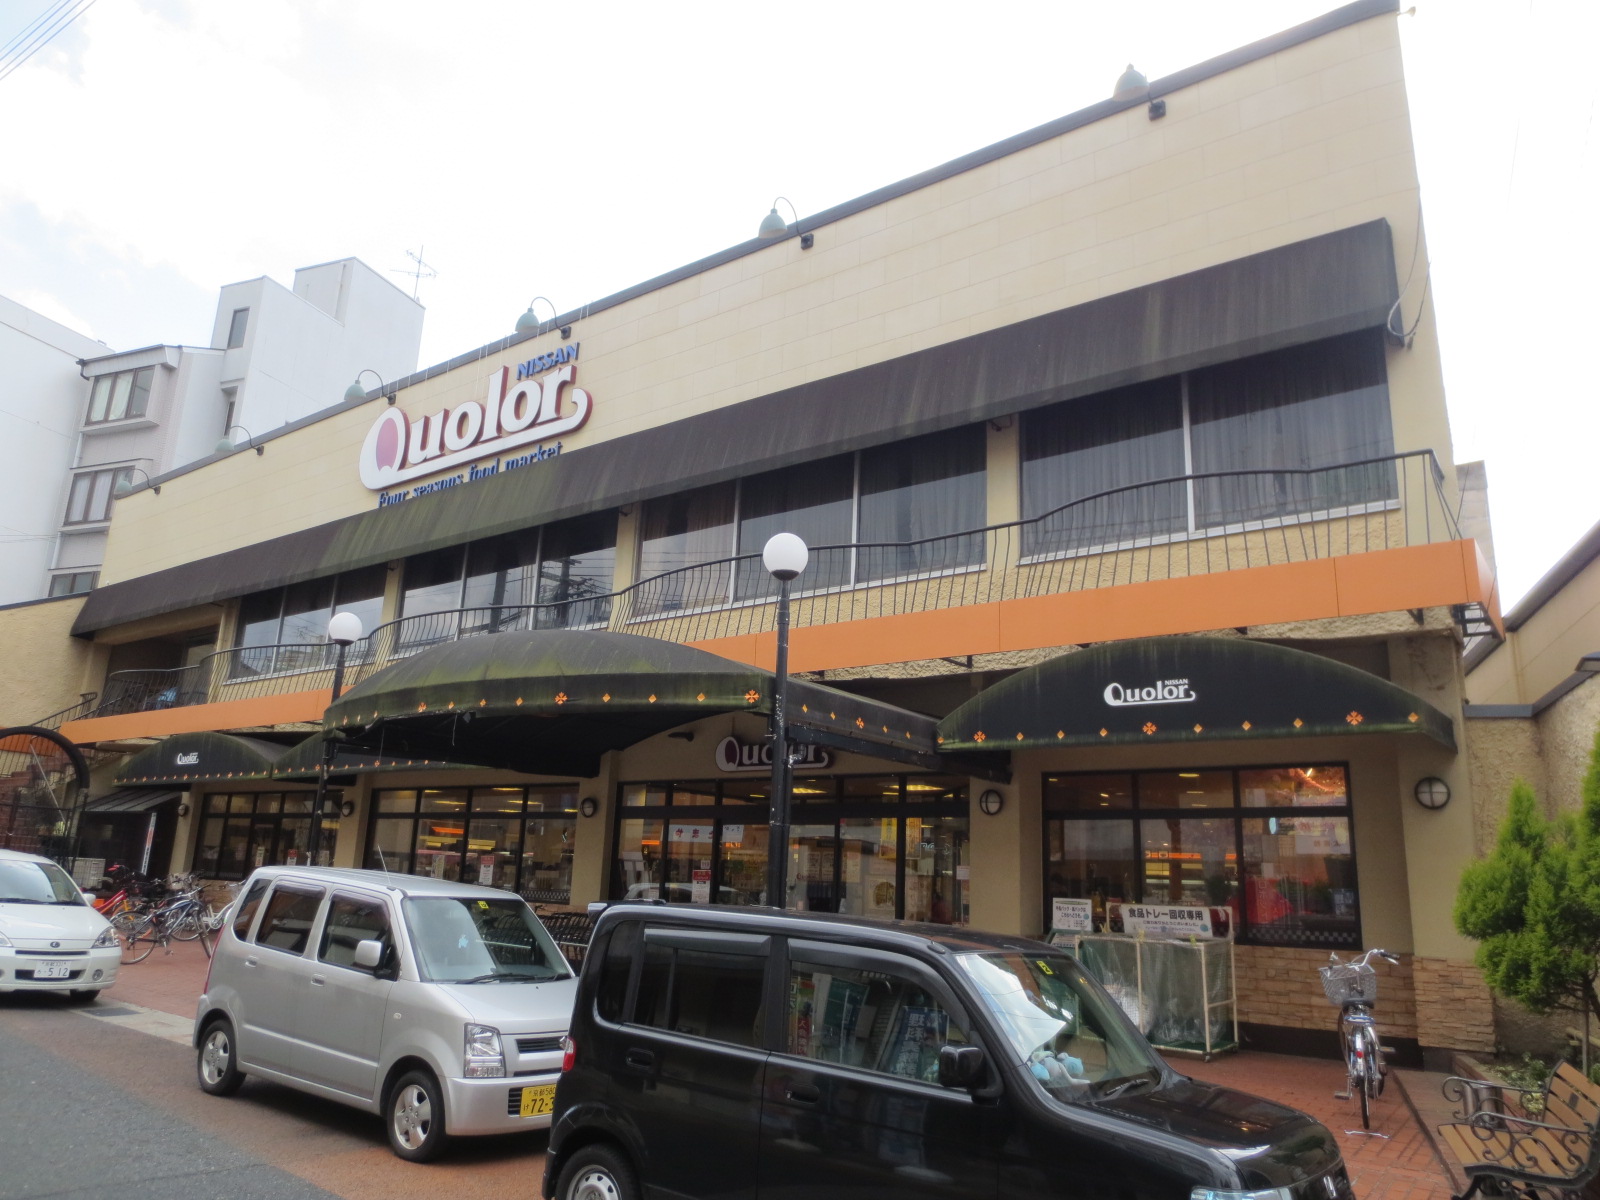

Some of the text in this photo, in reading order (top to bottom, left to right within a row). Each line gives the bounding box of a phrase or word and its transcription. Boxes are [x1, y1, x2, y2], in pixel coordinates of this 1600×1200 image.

[516, 341, 580, 380] NISSAN
[358, 365, 593, 491] Quolor
[412, 473, 464, 498] seasons
[468, 456, 500, 481] food
[504, 441, 563, 471] market
[1103, 680, 1196, 706] Quolor
[1164, 678, 1189, 686] NISSAN
[1128, 907, 1204, 921] 食品トレー回収専用
